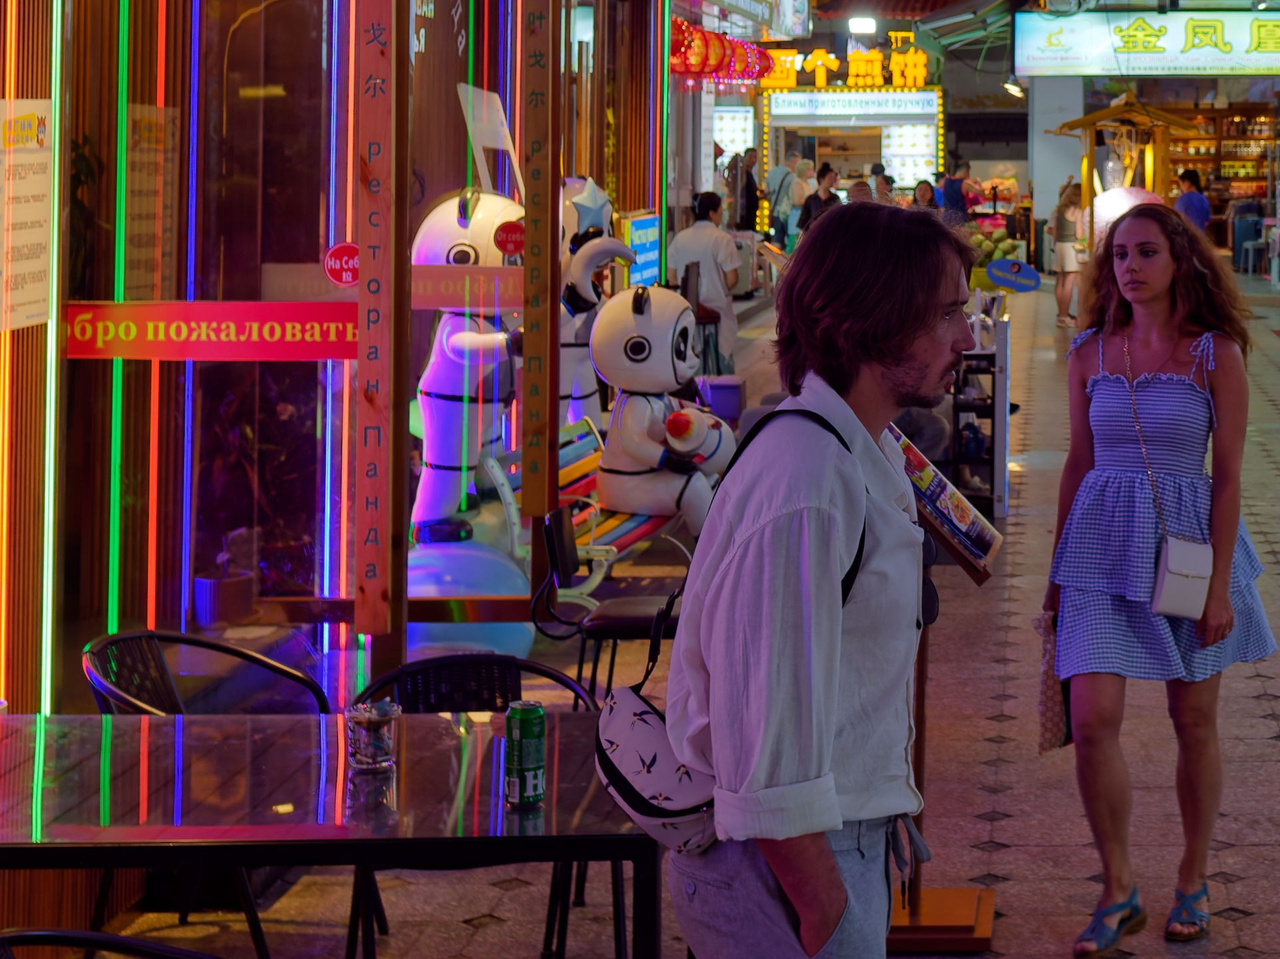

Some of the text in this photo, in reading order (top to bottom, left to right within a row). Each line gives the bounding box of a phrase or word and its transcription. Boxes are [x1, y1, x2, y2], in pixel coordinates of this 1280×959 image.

[774, 96, 934, 111] Блины приготовленные вручную
[327, 256, 340, 270] На
[366, 141, 382, 395] ресторан
[530, 139, 542, 333] ресторан
[67, 312, 359, 349] бро пожаловать
[528, 356, 542, 474] Панда
[363, 426, 382, 580] Панда
